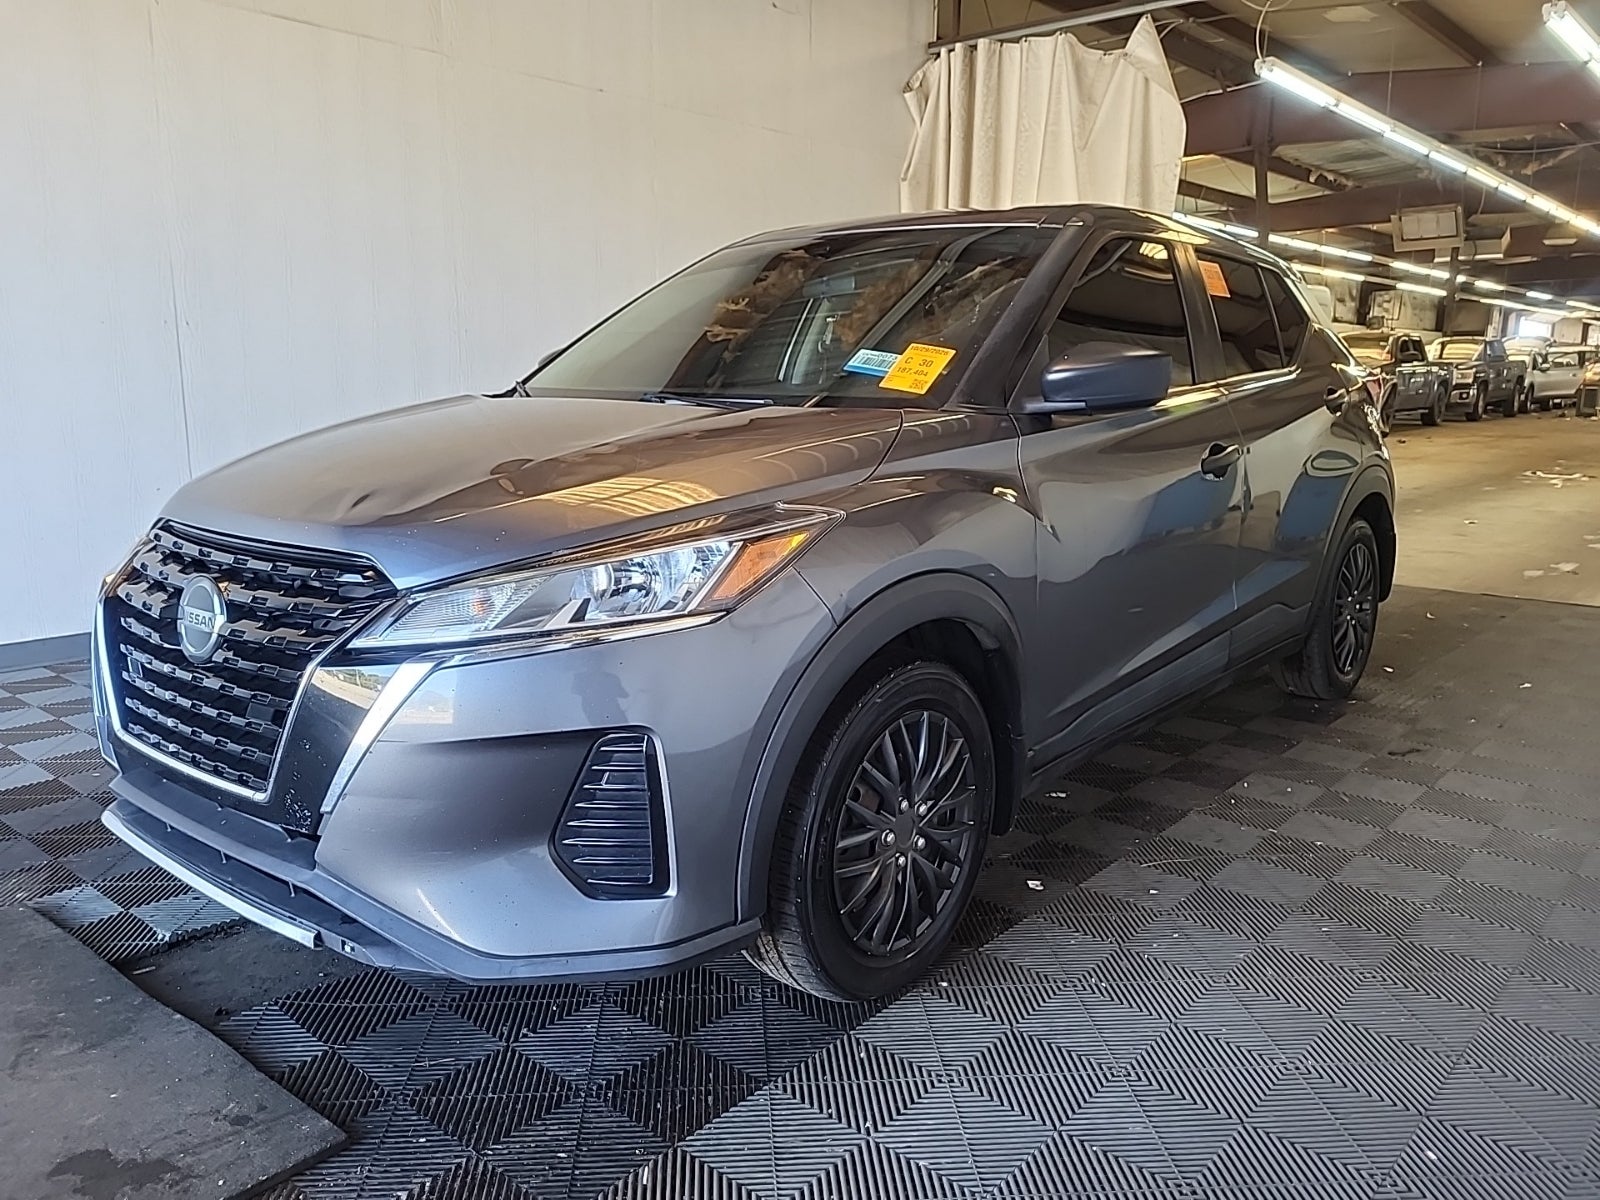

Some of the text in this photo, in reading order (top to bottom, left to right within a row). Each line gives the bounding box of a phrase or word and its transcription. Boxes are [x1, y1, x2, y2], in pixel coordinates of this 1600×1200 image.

[904, 356, 934, 368] C 30
[185, 610, 216, 630] SSAN
